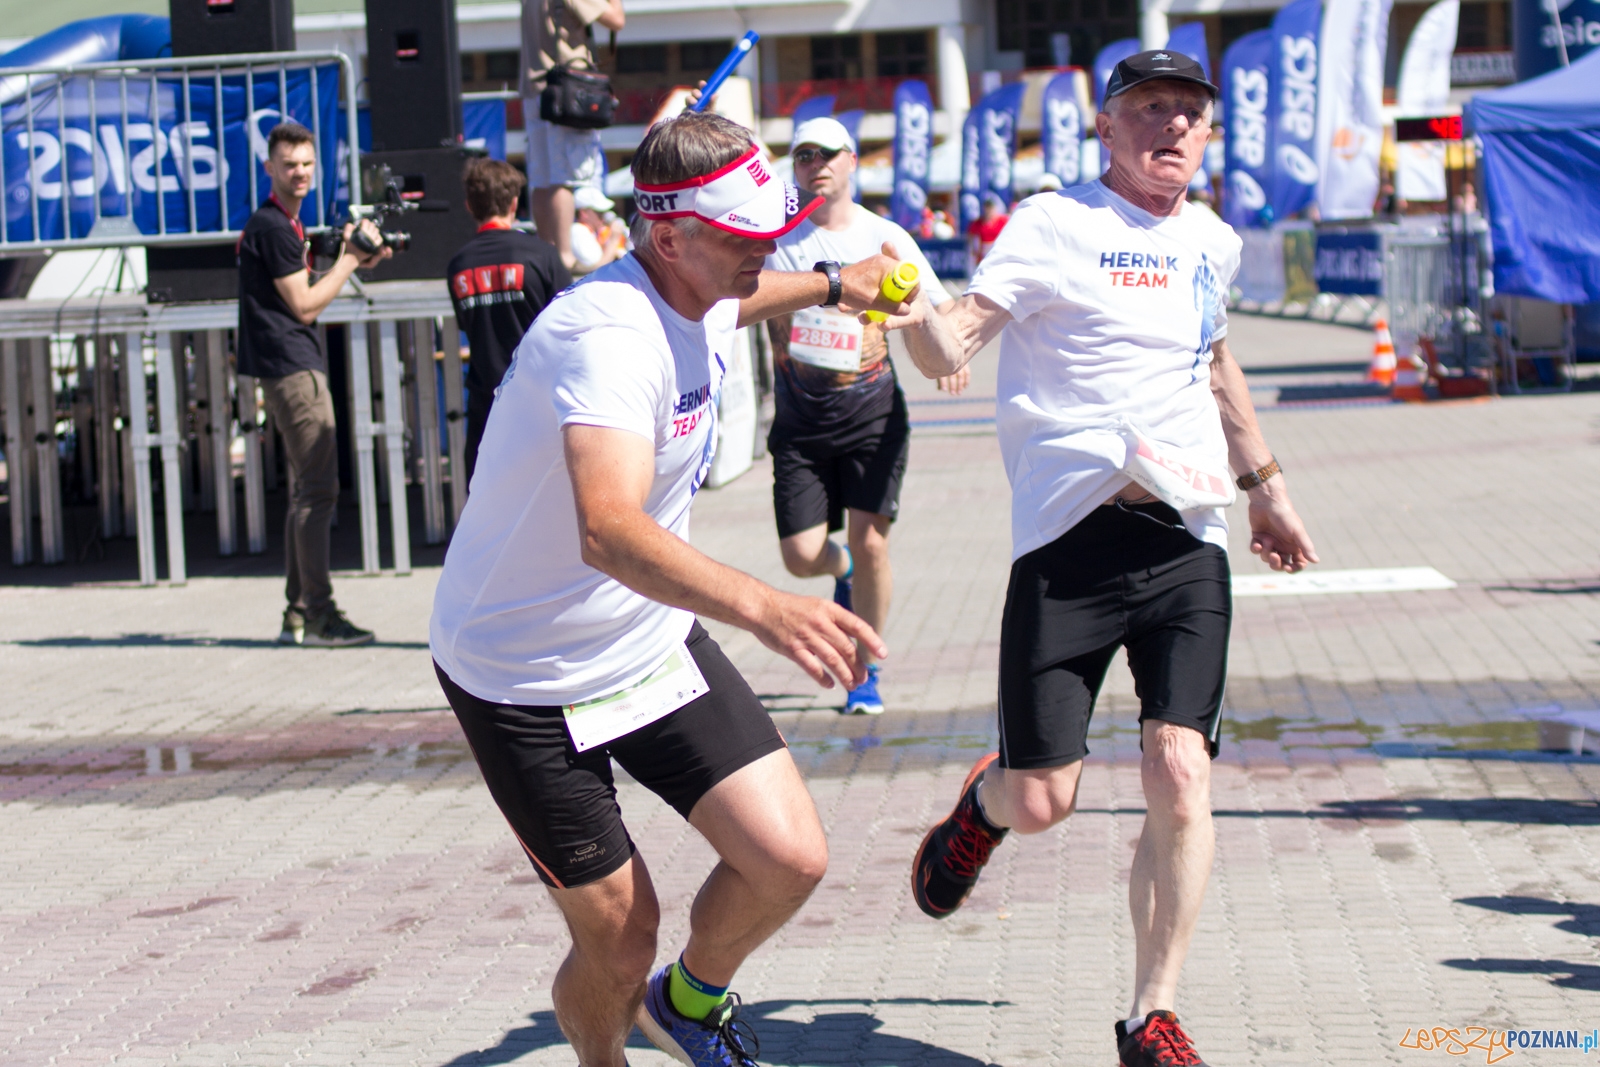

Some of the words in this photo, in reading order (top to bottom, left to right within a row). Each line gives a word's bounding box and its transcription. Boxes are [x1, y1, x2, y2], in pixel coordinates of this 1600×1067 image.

[1280, 34, 1318, 141] asics
[1232, 66, 1269, 168] asics
[1100, 252, 1179, 272] HERNIK
[457, 267, 517, 293] SVM
[1109, 271, 1168, 289] TEAM
[798, 328, 849, 349] 288/1
[672, 381, 712, 417] HERNIK
[570, 847, 606, 864] Kalenji
